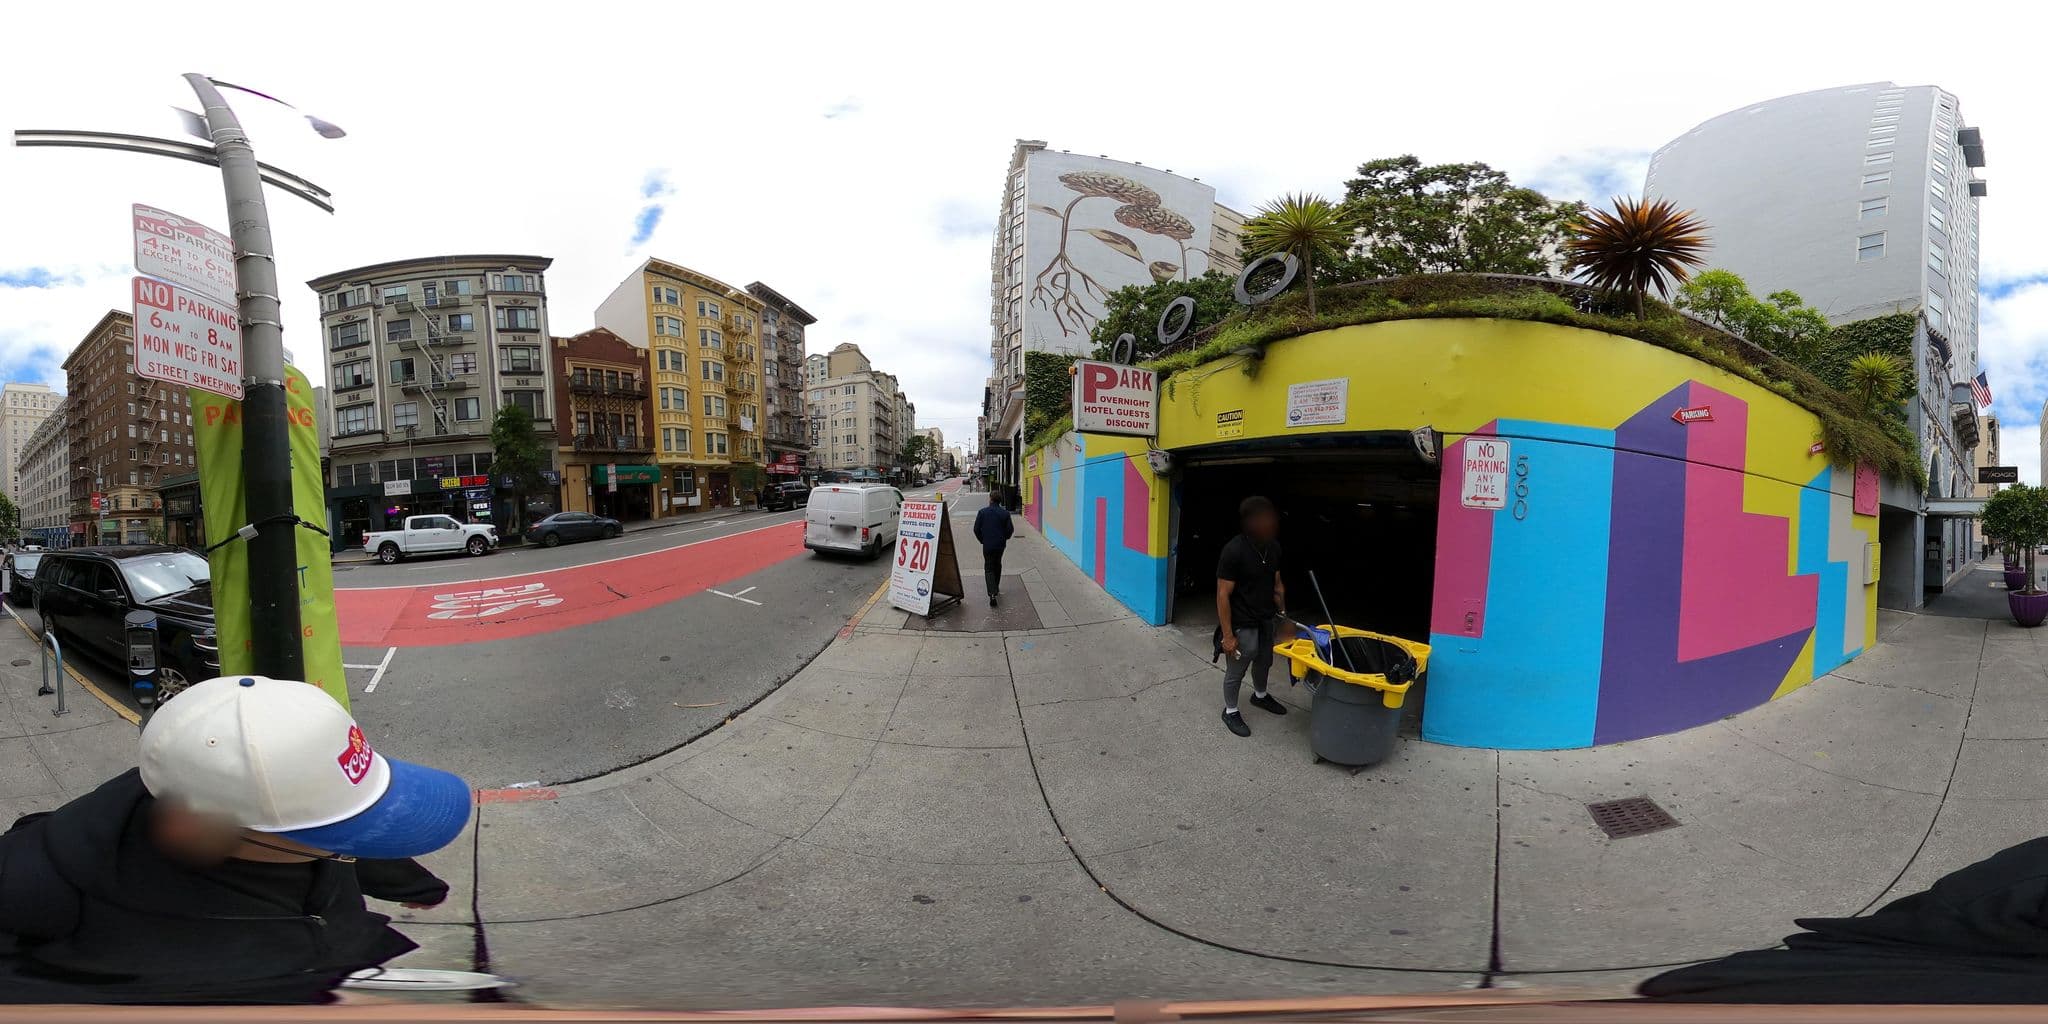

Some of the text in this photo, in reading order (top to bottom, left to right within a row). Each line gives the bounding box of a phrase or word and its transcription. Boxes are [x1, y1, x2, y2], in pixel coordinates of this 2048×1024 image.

[140, 220, 234, 263] NO PARKING
[143, 249, 182, 267] EXCEPT
[187, 263, 203, 274] SAT
[140, 279, 169, 307] NO
[178, 296, 236, 331] PARKING
[143, 333, 237, 376] MON WED FRI SAT
[148, 361, 237, 394] STREET SWEEPING
[1083, 363, 1153, 404] PARK
[1100, 395, 1150, 408] OVERNIGHT
[1084, 405, 1150, 419] HOTEL GUESTS
[1218, 410, 1242, 422] CAUTION
[1681, 409, 1709, 420] PARKING
[1106, 418, 1150, 430] DISCOUNT
[1478, 445, 1495, 458] NO
[1466, 459, 1505, 473] PARKING
[1476, 474, 1494, 484] ANY
[1475, 484, 1495, 494] TIME
[1513, 455, 1529, 521] 560
[904, 503, 937, 511] PUBLIC
[903, 511, 937, 520] PARKING
[909, 540, 930, 571] 20
